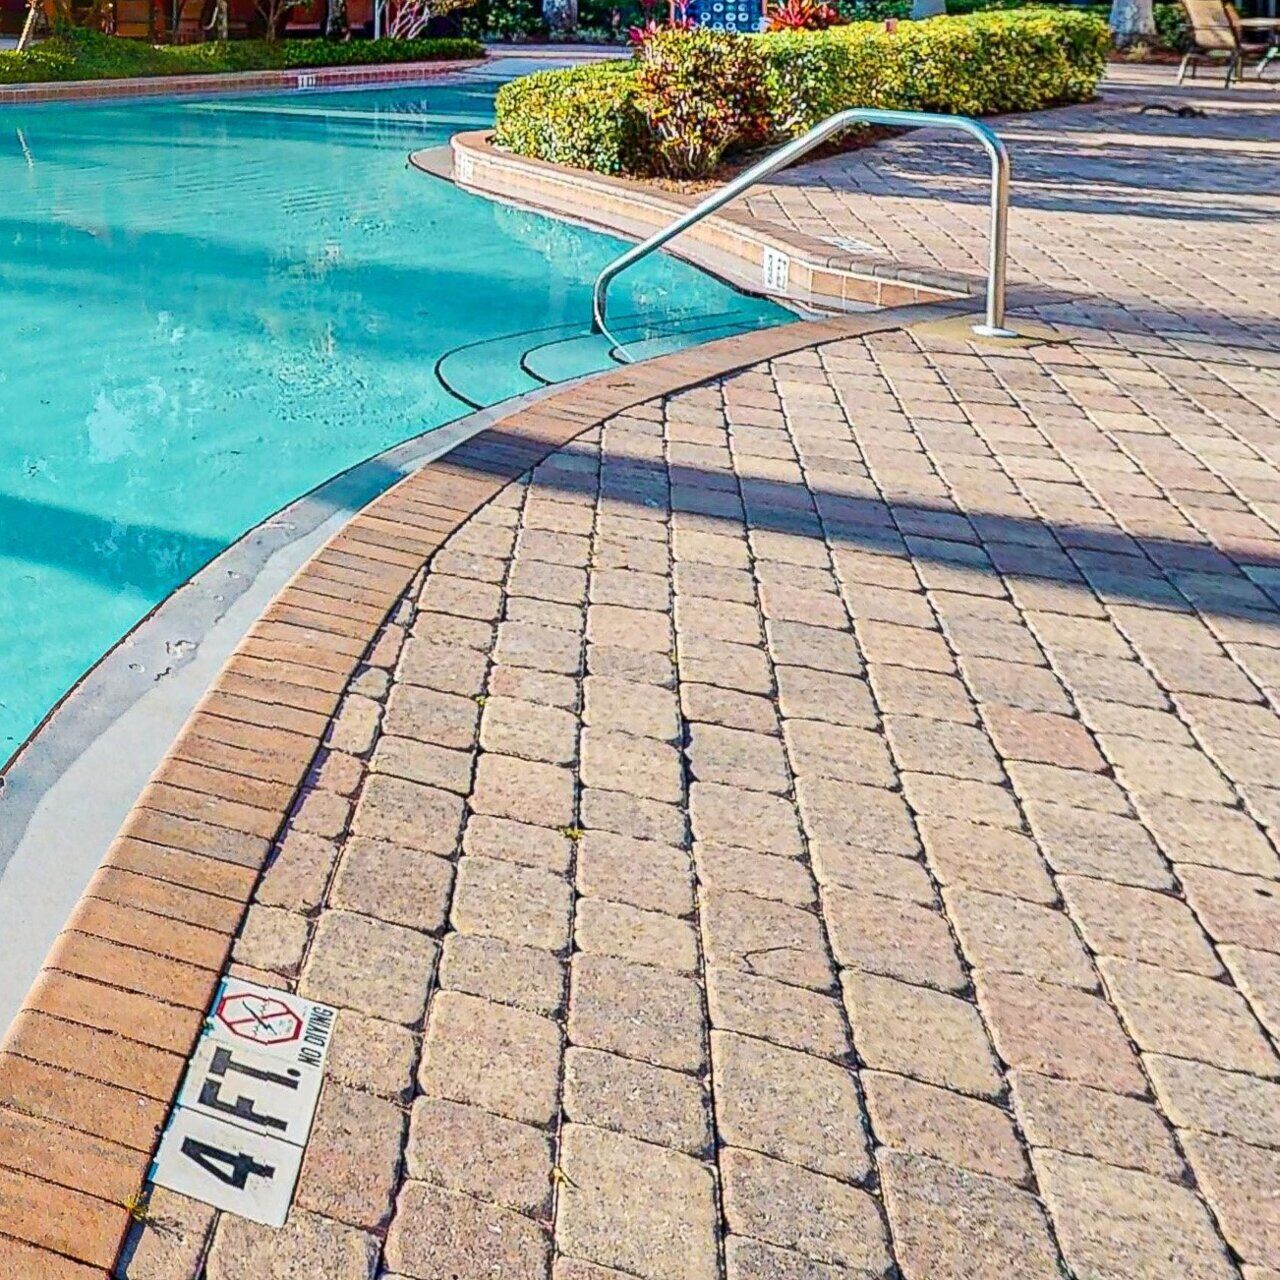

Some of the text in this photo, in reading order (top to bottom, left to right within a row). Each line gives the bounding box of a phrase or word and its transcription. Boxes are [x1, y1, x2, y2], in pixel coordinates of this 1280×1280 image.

[297, 1045, 321, 1068] NO
[180, 1046, 301, 1191] 4 FT.
